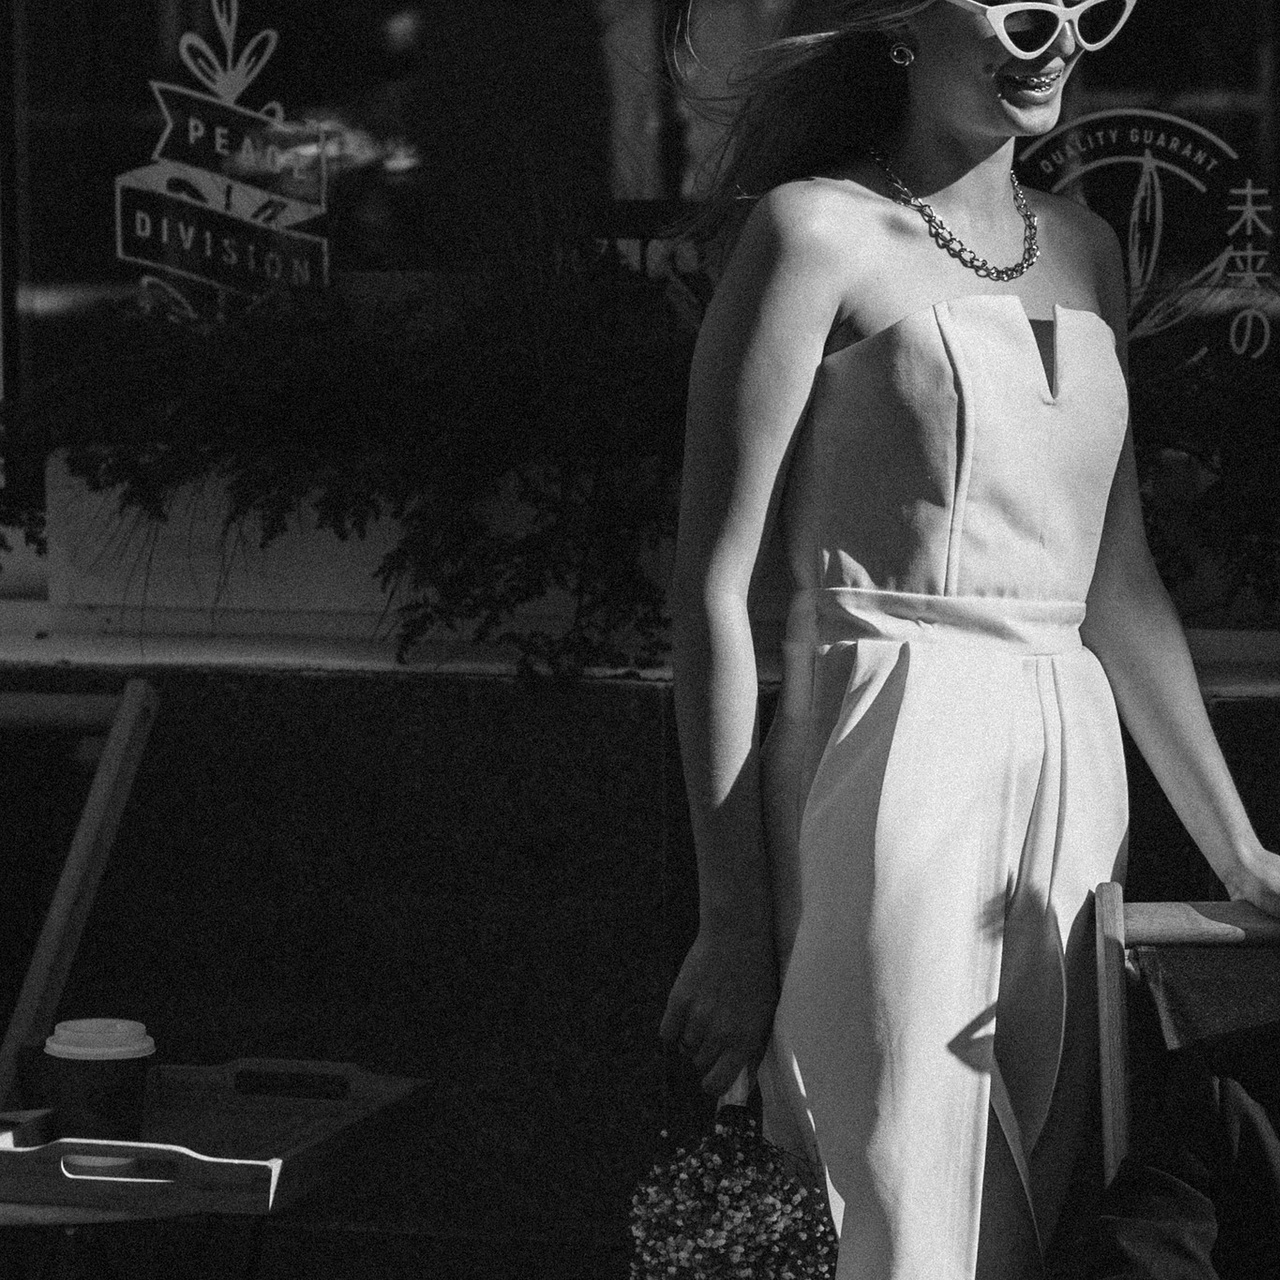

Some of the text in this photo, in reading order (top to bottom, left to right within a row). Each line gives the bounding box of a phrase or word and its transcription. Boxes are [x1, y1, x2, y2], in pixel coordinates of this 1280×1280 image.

[1040, 128, 1219, 174] QUALITY GUARANT
[135, 210, 310, 286] DIVISION
